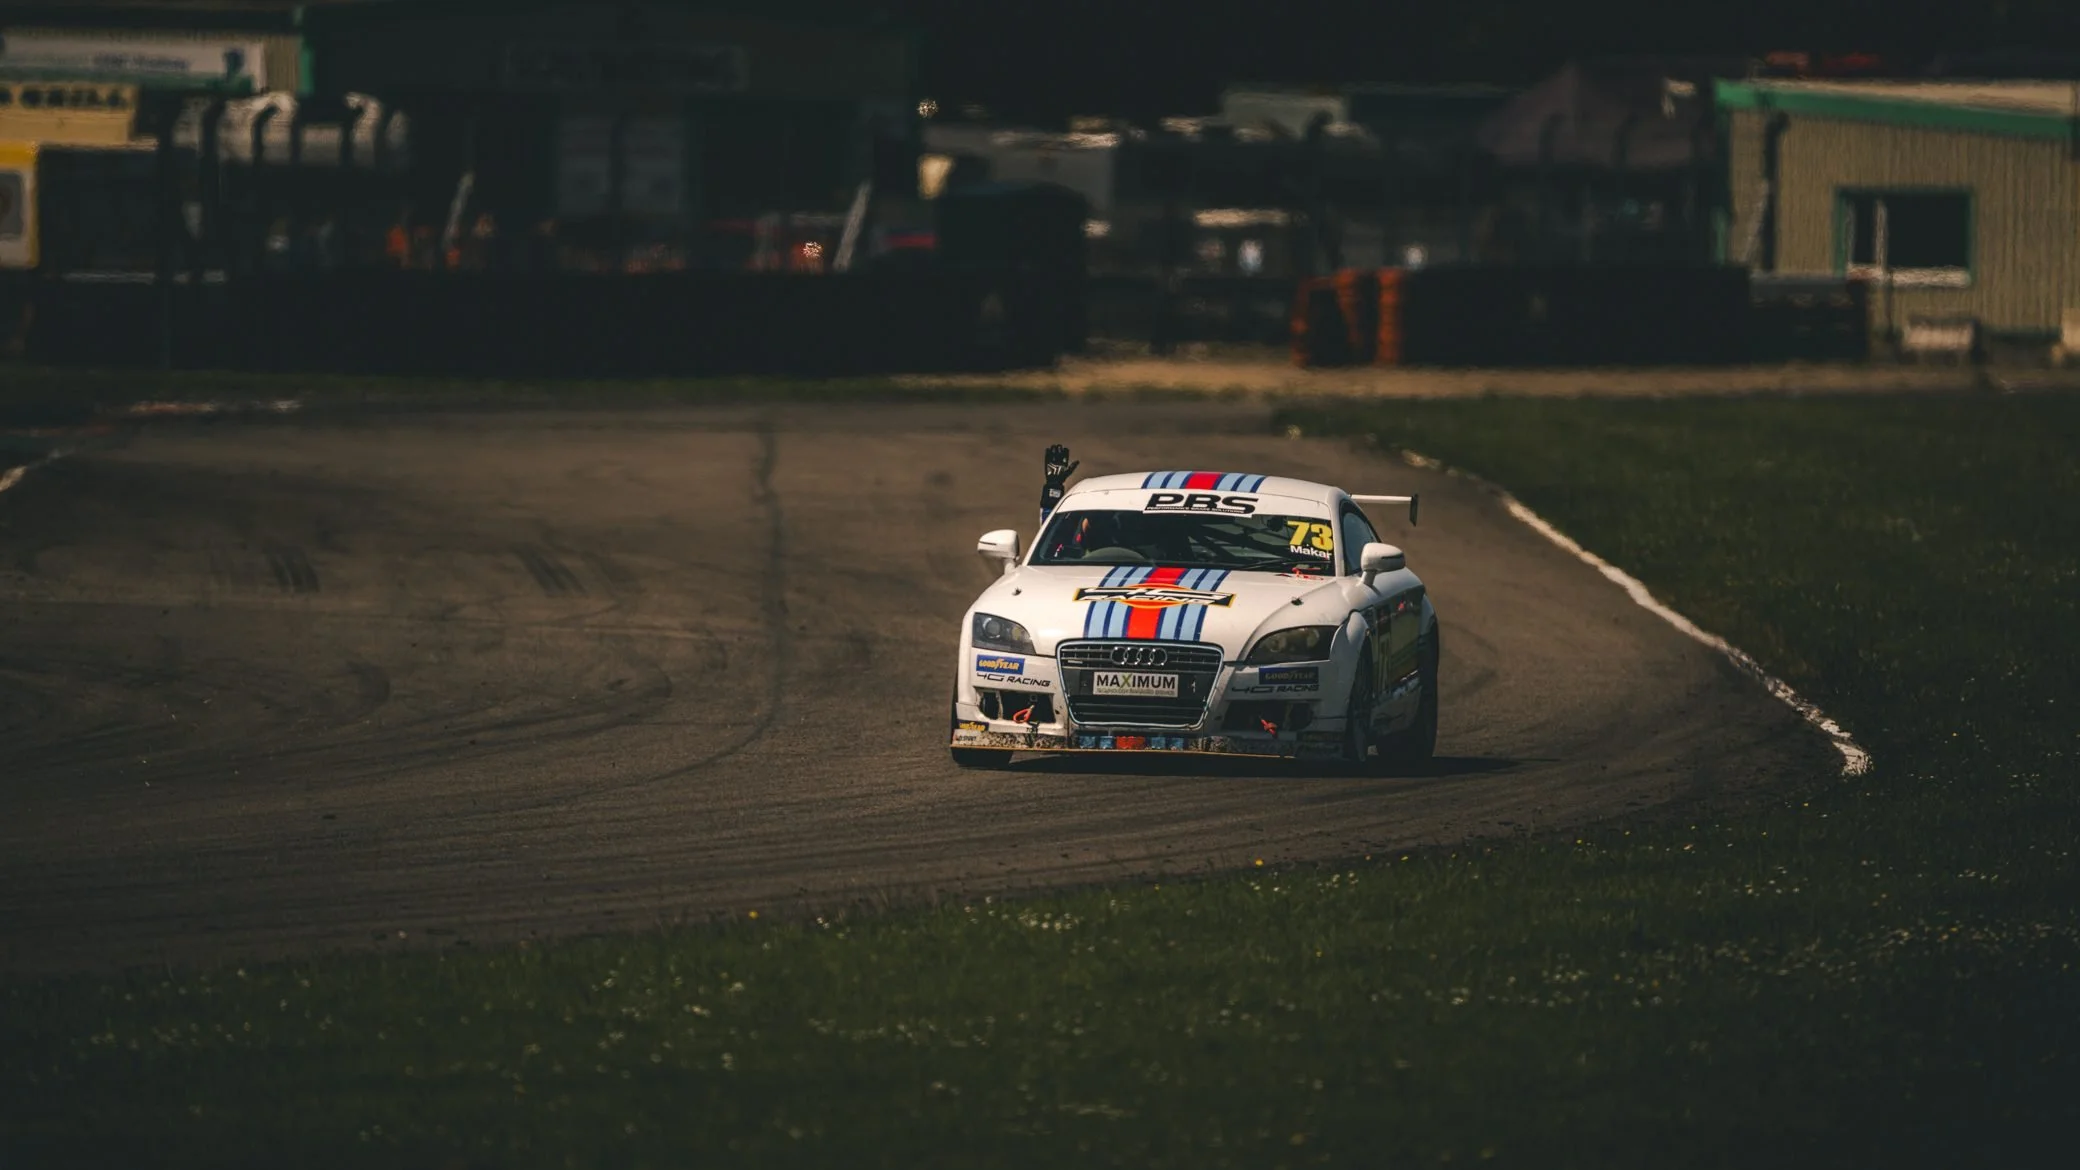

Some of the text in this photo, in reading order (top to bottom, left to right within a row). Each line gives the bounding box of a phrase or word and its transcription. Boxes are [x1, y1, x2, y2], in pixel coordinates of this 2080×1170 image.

[1144, 493, 1259, 515] PBS
[1287, 520, 1334, 551] 73
[978, 658, 1020, 670] GOODYEAR
[976, 672, 1051, 687] 4G RACING
[1096, 674, 1176, 690] MAXIMUM
[1276, 684, 1319, 694] RACING
